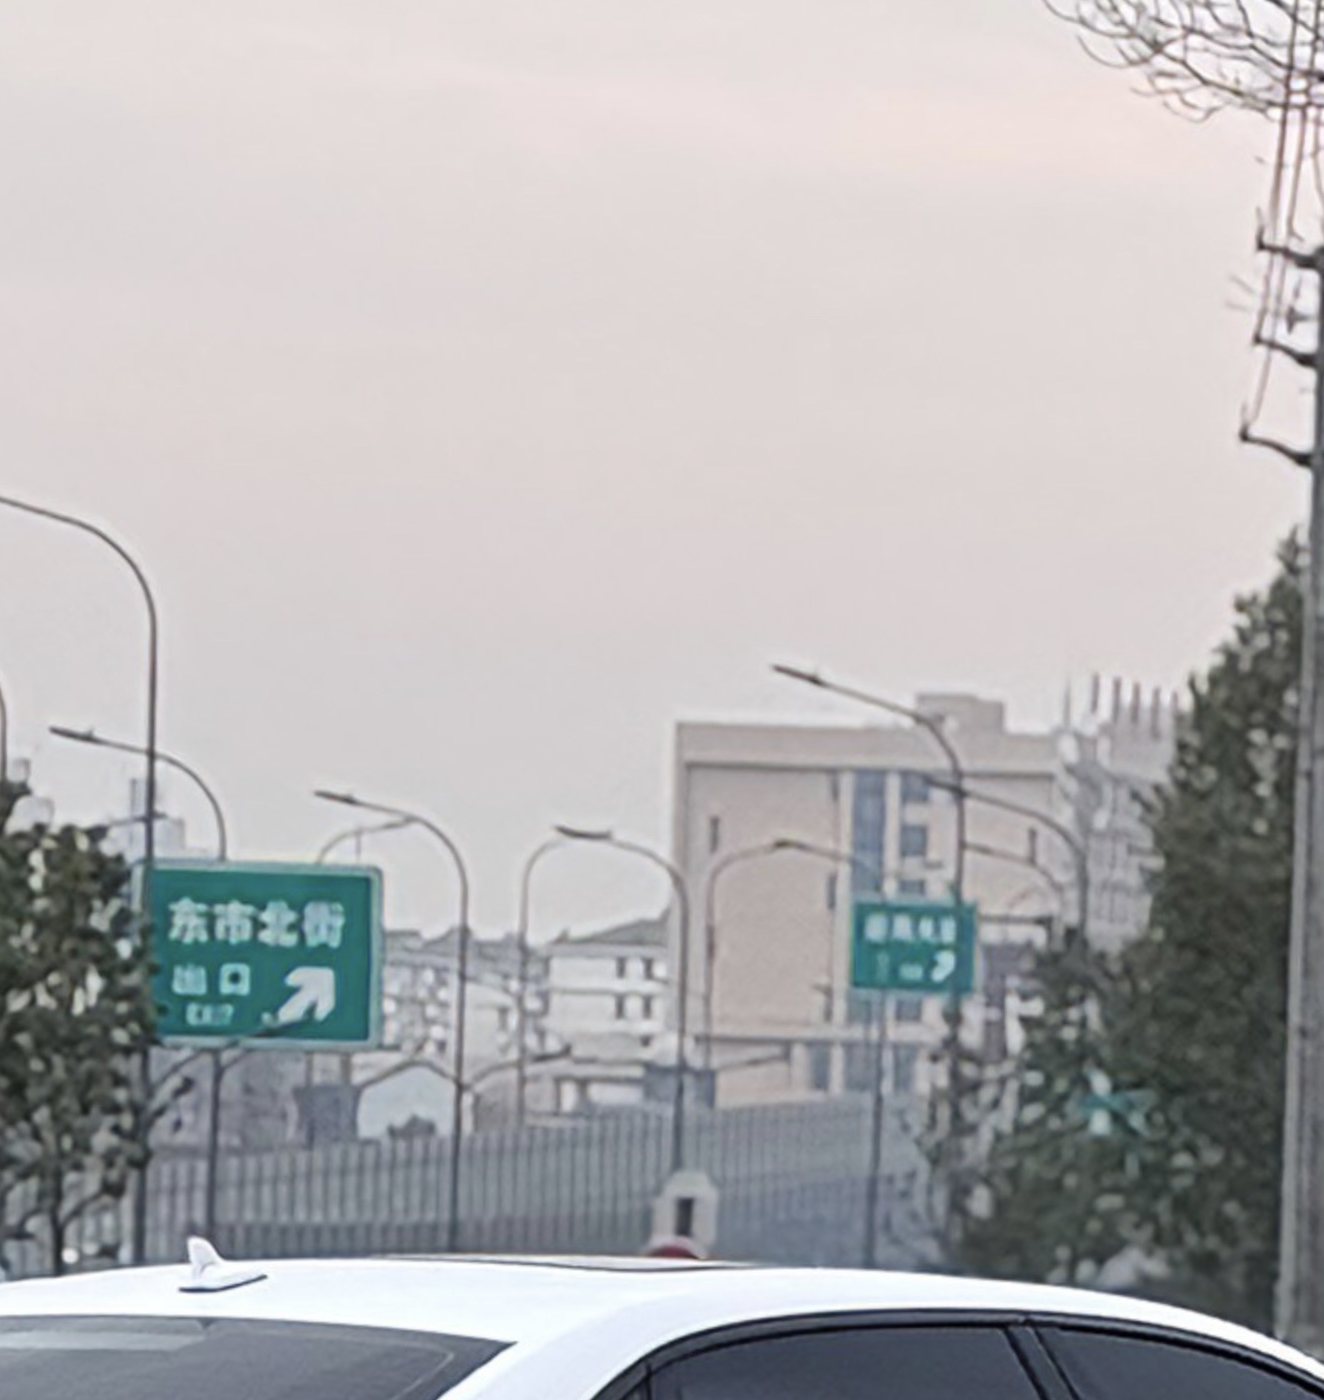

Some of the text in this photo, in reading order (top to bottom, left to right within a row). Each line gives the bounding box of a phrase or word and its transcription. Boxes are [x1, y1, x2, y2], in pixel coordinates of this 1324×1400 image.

[168, 897, 345, 949] 东市北街
[172, 962, 251, 996] 出口
